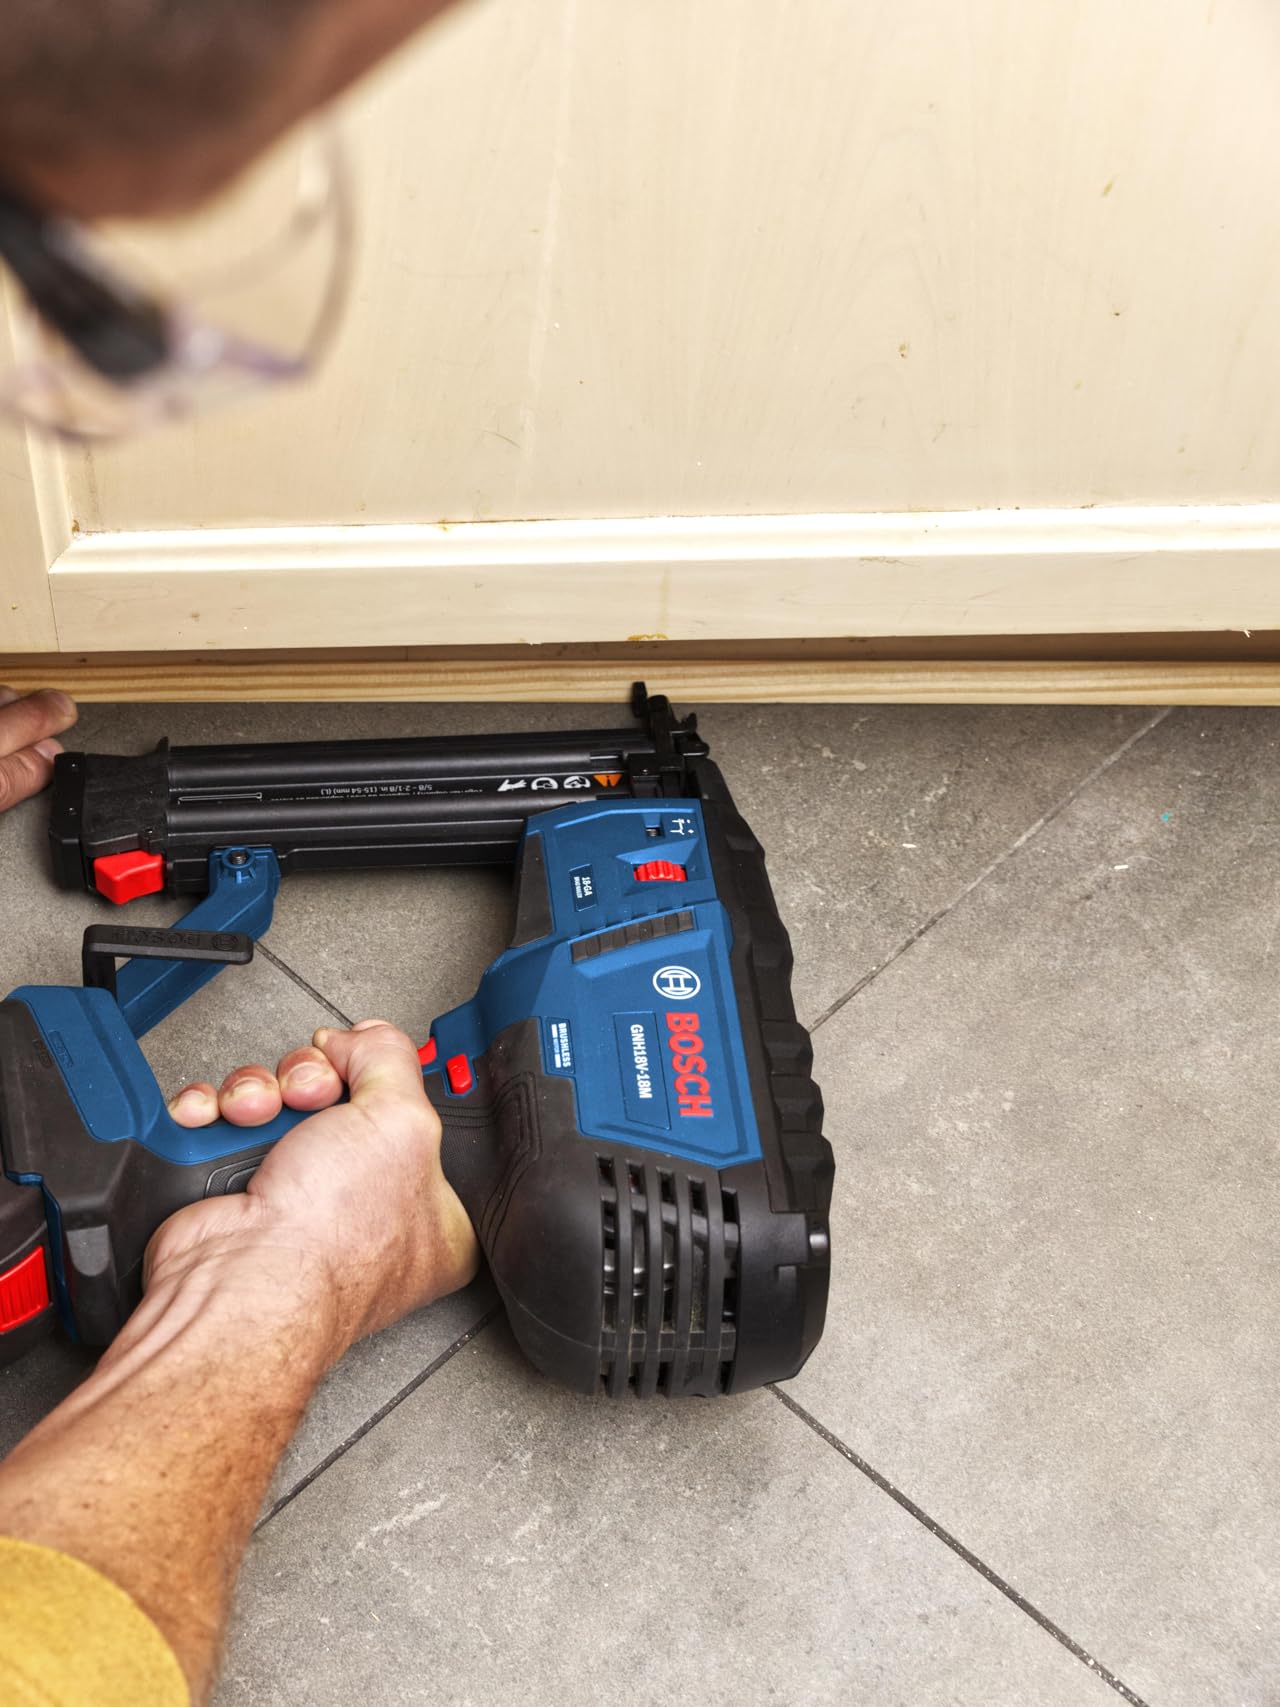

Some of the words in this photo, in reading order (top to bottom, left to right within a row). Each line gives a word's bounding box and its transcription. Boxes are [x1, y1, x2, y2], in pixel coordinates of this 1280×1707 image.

[581, 877, 593, 897] 18-GA
[558, 1023, 571, 1068] BRUSHLESS
[630, 1024, 653, 1099] GNH18V-18M
[665, 1011, 714, 1118] BOSCH
